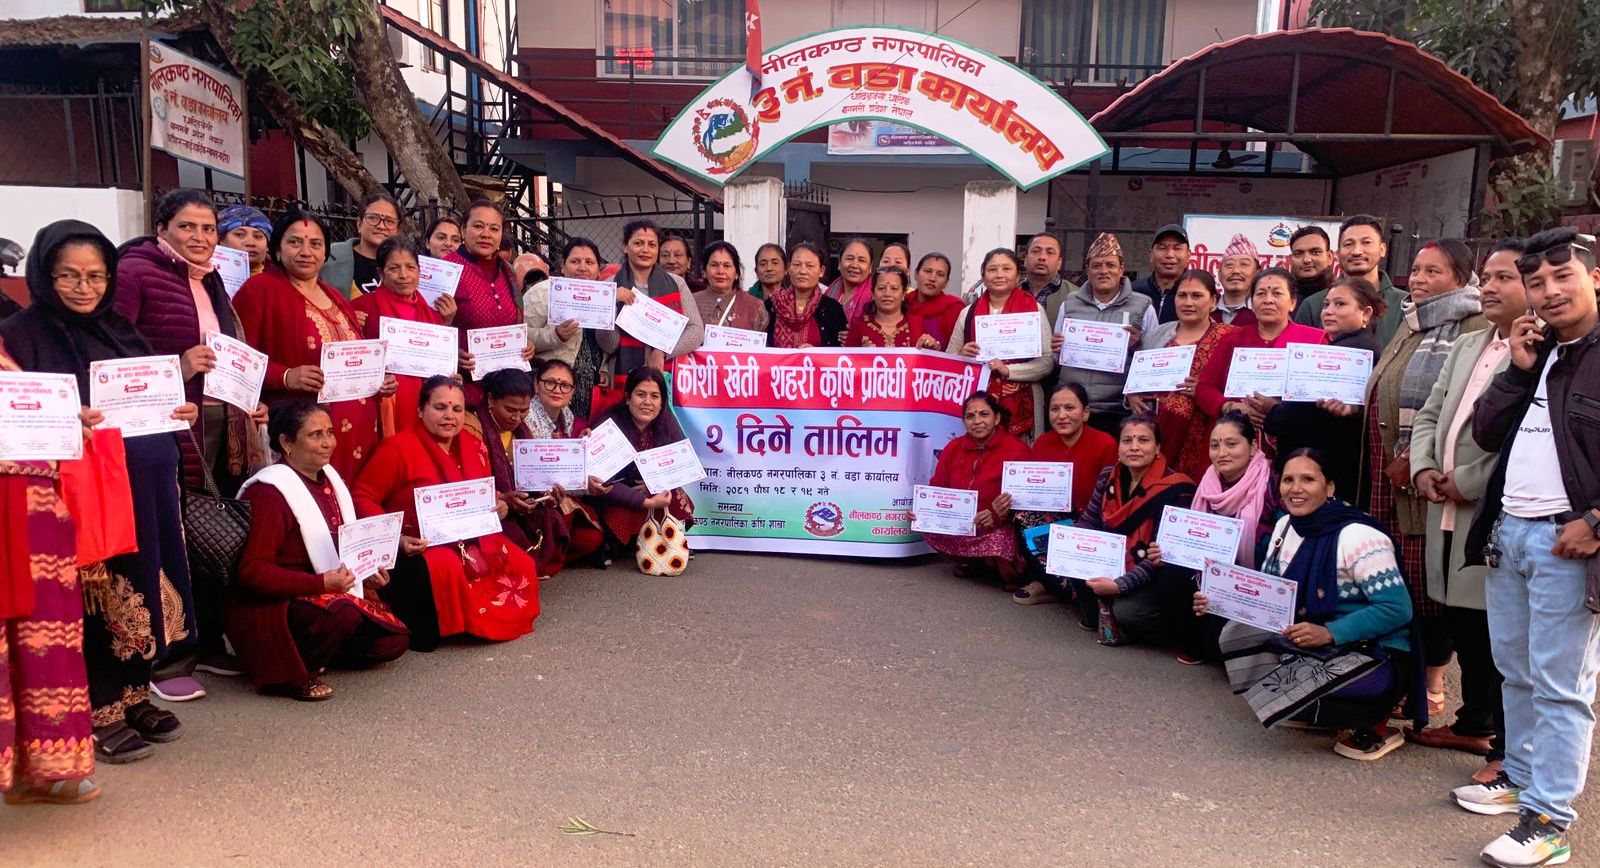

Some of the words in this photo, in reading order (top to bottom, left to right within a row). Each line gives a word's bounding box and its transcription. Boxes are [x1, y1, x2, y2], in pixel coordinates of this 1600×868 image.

[761, 36, 867, 75] नीलकण्ठ
[872, 36, 985, 77] नगरपालिका
[192, 67, 243, 122] नगरपालिका
[752, 86, 781, 123] ३
[827, 62, 918, 94] वडा
[921, 72, 1064, 172] कार्यालय
[676, 354, 719, 398] कौशी
[723, 355, 760, 400] खेती
[770, 355, 814, 400] शहरी
[820, 355, 856, 408] कृषि
[860, 355, 907, 403] प्रविधी
[912, 365, 976, 407] सम्बन्धी
[705, 424, 724, 454] २
[736, 413, 794, 457] दिने
[803, 415, 901, 458] तालिम
[725, 487, 749, 496] २०८१
[791, 488, 797, 496] र
[726, 467, 763, 479] नीलकण्ठ
[766, 467, 817, 480] नगरपालिका
[820, 470, 826, 480] ३
[844, 471, 860, 482] वडा
[864, 469, 900, 483] कार्यालय
[711, 516, 748, 528] नगरपालिका
[717, 502, 743, 512] समन्वय
